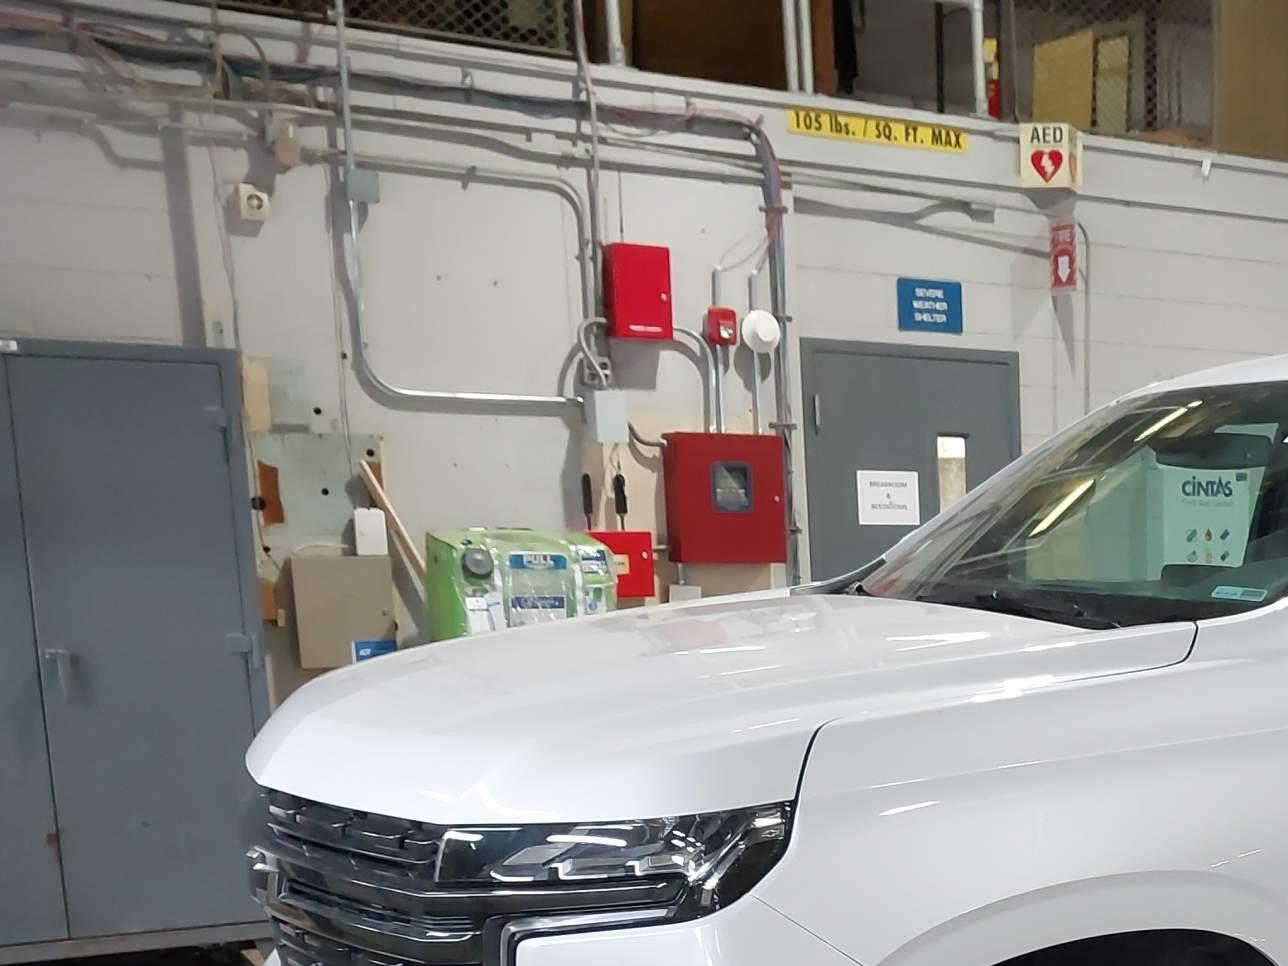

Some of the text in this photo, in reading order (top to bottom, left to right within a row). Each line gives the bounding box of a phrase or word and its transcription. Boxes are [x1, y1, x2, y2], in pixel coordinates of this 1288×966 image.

[794, 111, 822, 132] 105
[829, 116, 856, 137] lbs.
[875, 123, 898, 141] SQ.
[905, 127, 924, 145] FT.
[931, 130, 963, 149] MAX
[1029, 126, 1064, 144] AED
